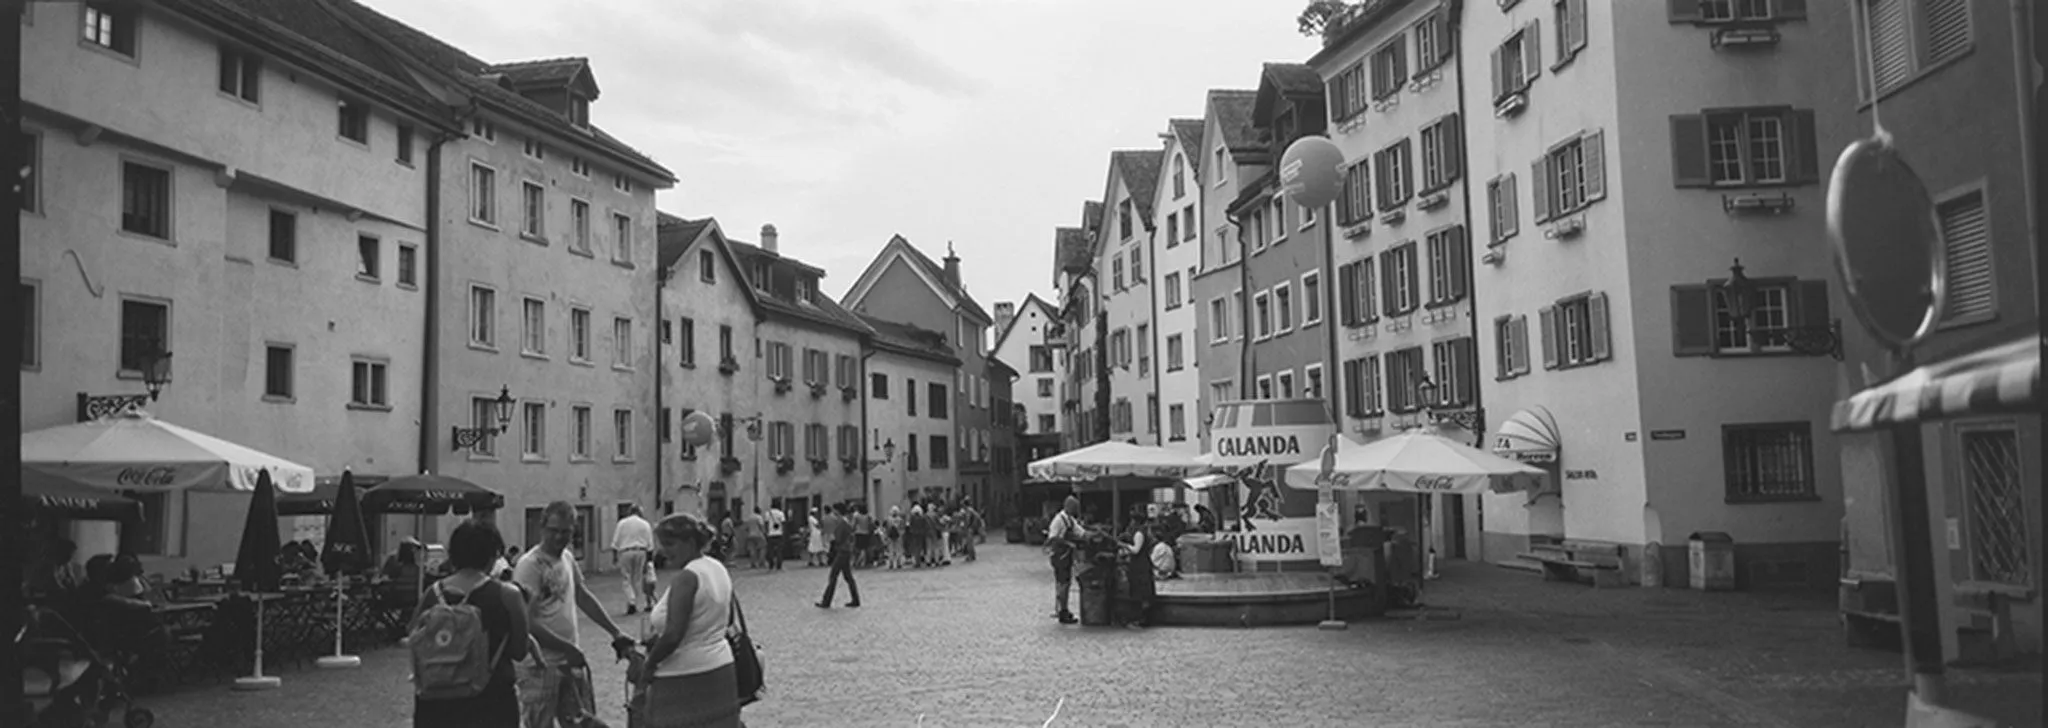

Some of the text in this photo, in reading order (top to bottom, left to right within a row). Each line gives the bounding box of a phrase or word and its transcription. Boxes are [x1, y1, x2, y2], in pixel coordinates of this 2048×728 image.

[1217, 434, 1301, 457] CALANDA
[117, 467, 176, 486] Coca-Cola
[1414, 474, 1455, 490] Coca-Cola
[1222, 533, 1305, 554] ALANDA
